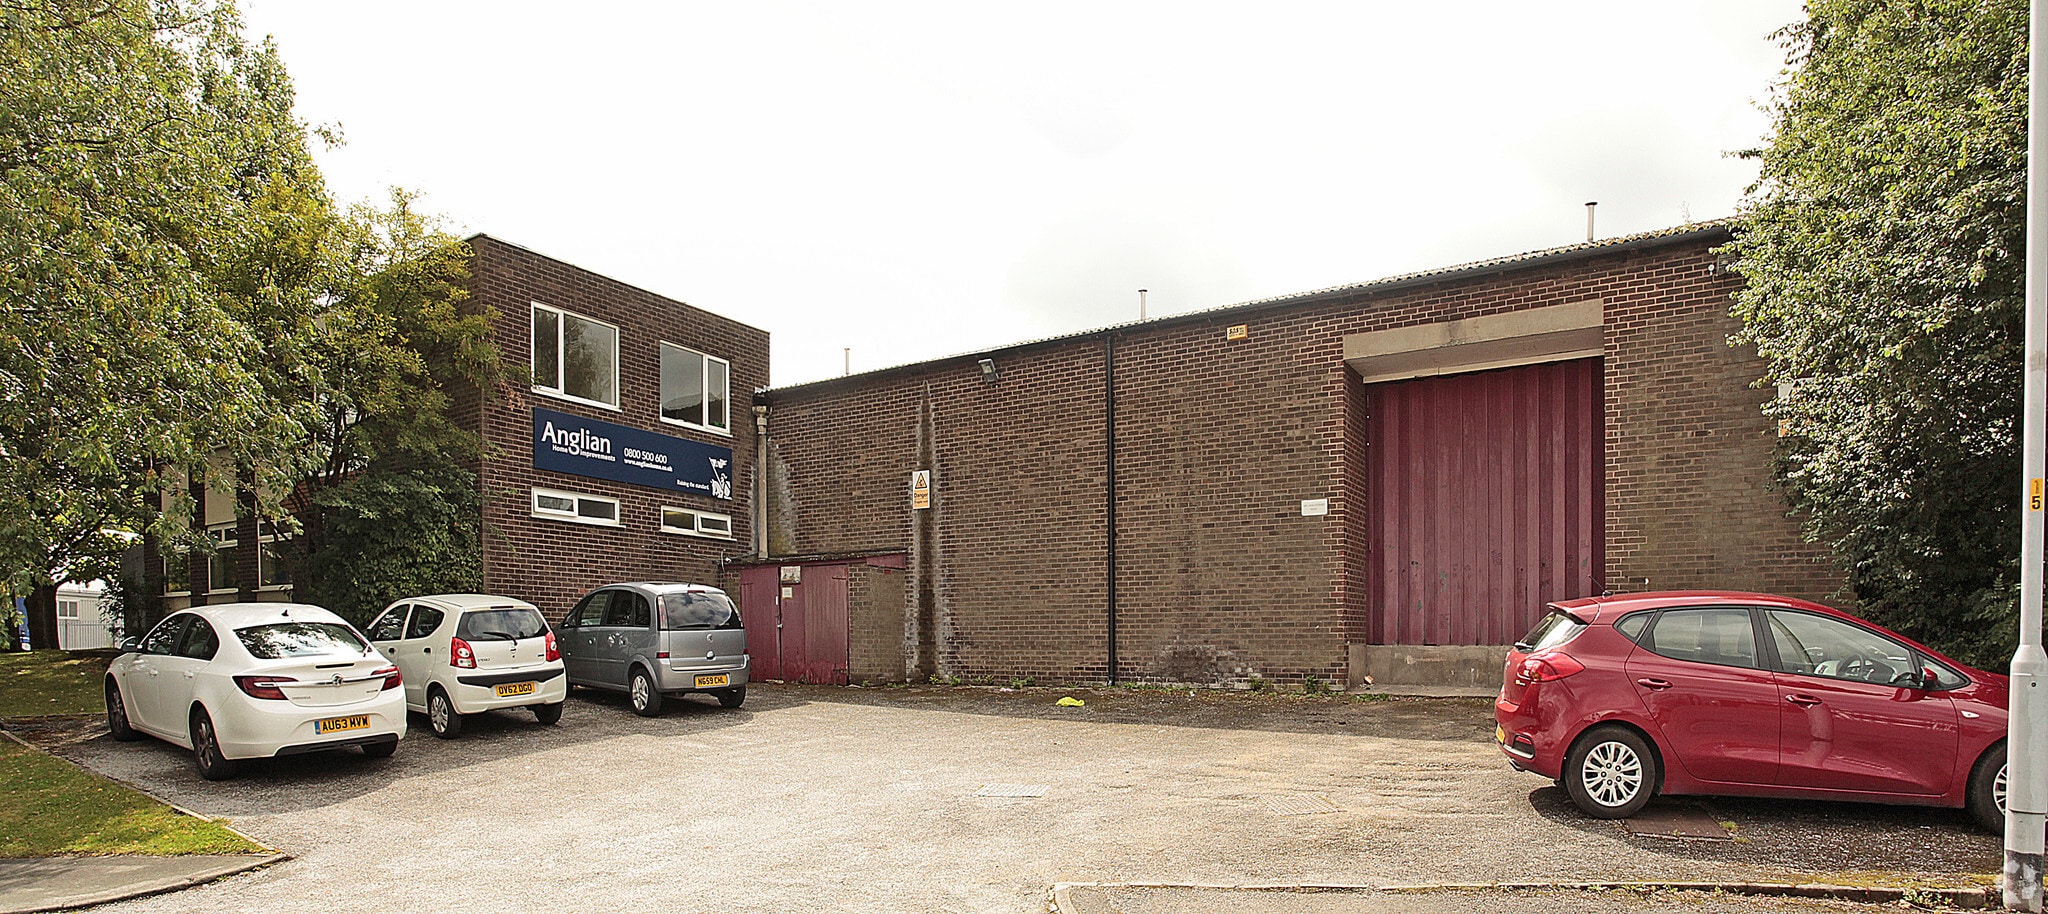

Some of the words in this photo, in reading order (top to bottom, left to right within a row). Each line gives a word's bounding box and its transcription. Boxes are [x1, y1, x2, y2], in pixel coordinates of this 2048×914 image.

[541, 421, 612, 455] Anglian
[552, 444, 568, 453] Home
[623, 447, 641, 460] 0800
[641, 450, 654, 462] 500
[655, 453, 668, 464] 600
[322, 718, 348, 732] AU63
